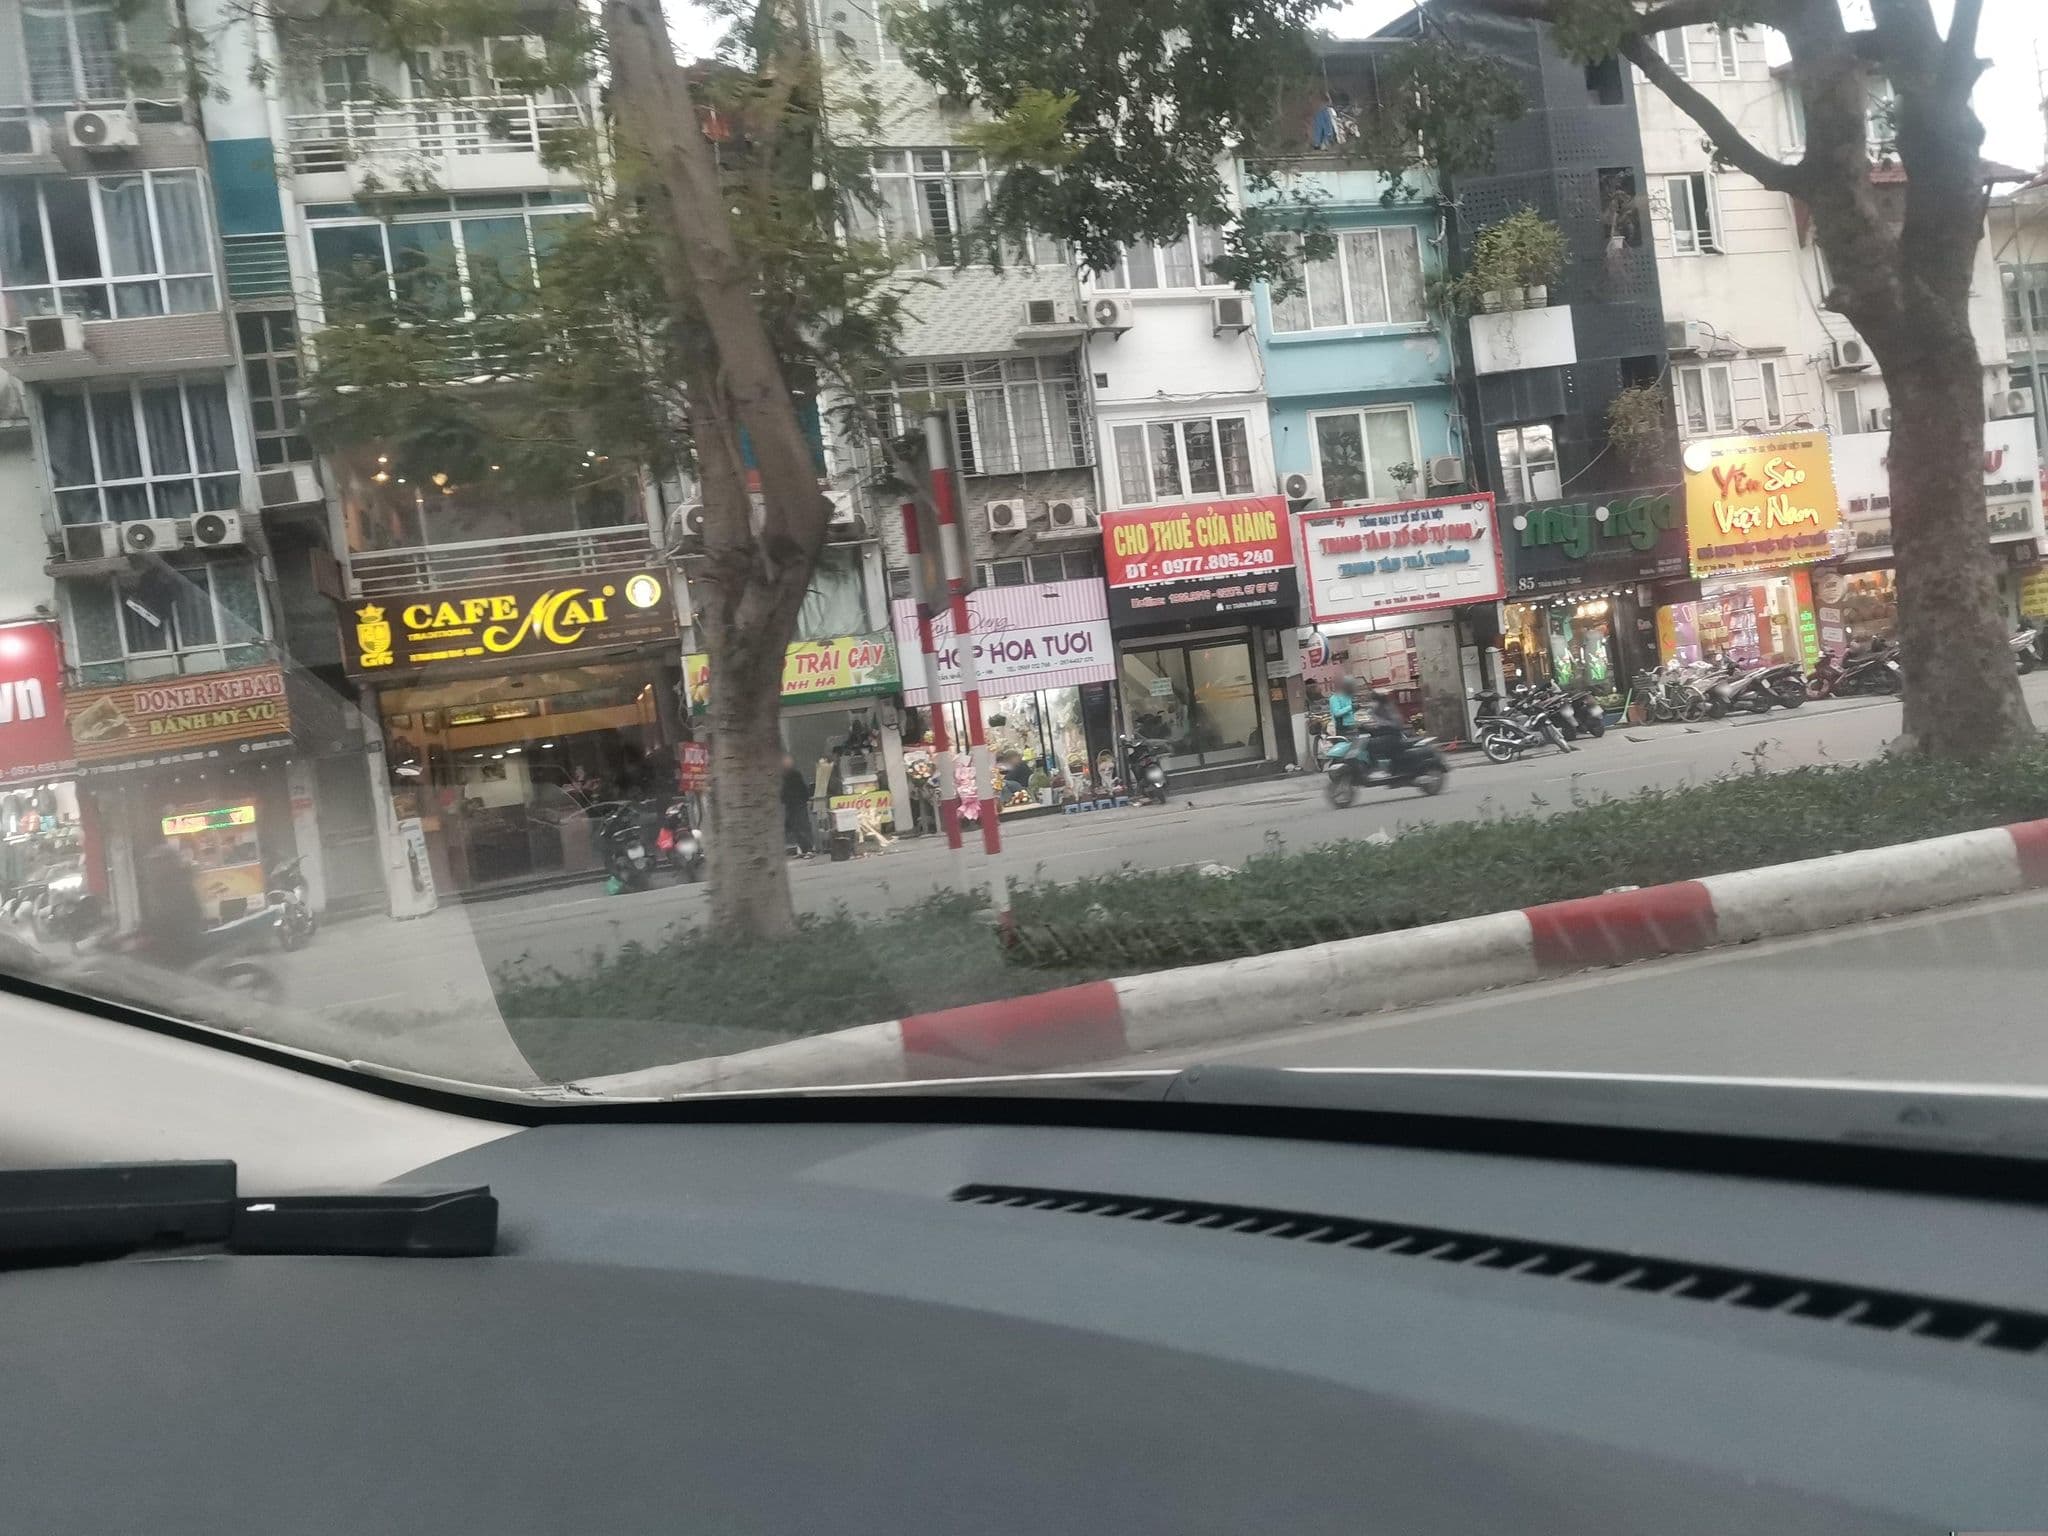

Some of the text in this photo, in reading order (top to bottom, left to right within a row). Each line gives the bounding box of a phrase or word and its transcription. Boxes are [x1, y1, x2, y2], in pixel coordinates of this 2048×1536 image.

[1763, 456, 1806, 491] Sào
[1712, 499, 1762, 534] Việt
[1765, 493, 1819, 529] Nam
[1113, 505, 1279, 557] CHO THUÊ CỬA HÀNG
[1162, 548, 1275, 576] 0977.805.240
[1518, 576, 1536, 591] 85
[402, 595, 519, 630] CAFE
[848, 641, 885, 669] CÂY
[990, 638, 1038, 665] HOA
[1042, 631, 1094, 657] TƯƠI
[136, 674, 282, 714] DONER KEBAB
[150, 713, 207, 735] BÁNH
